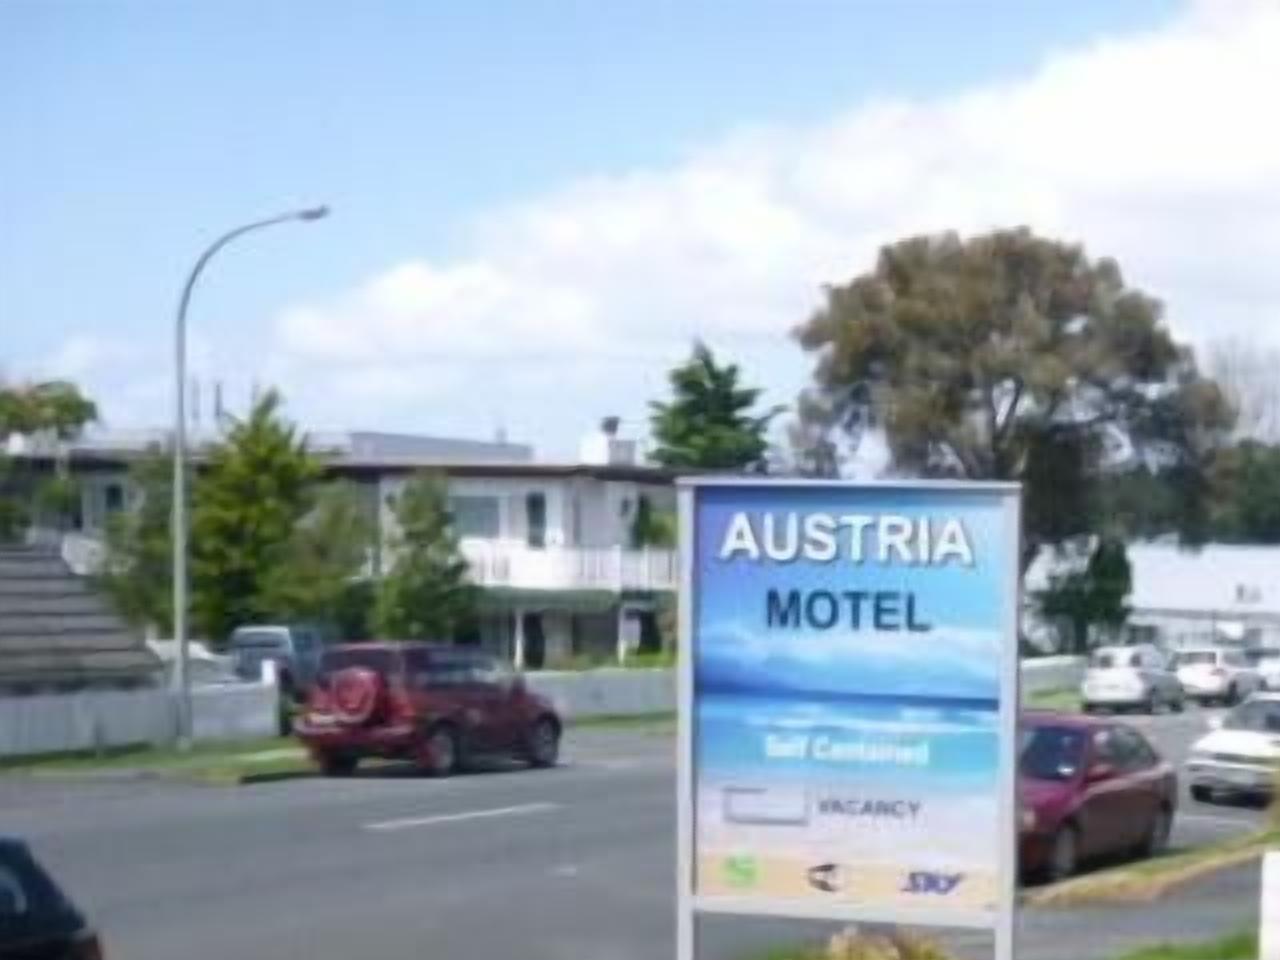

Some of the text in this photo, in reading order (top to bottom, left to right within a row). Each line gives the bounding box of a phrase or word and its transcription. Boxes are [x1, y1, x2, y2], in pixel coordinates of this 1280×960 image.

[719, 512, 974, 565] AUSTRIA
[766, 588, 933, 631] MOTEL
[817, 799, 922, 818] VACANCY
